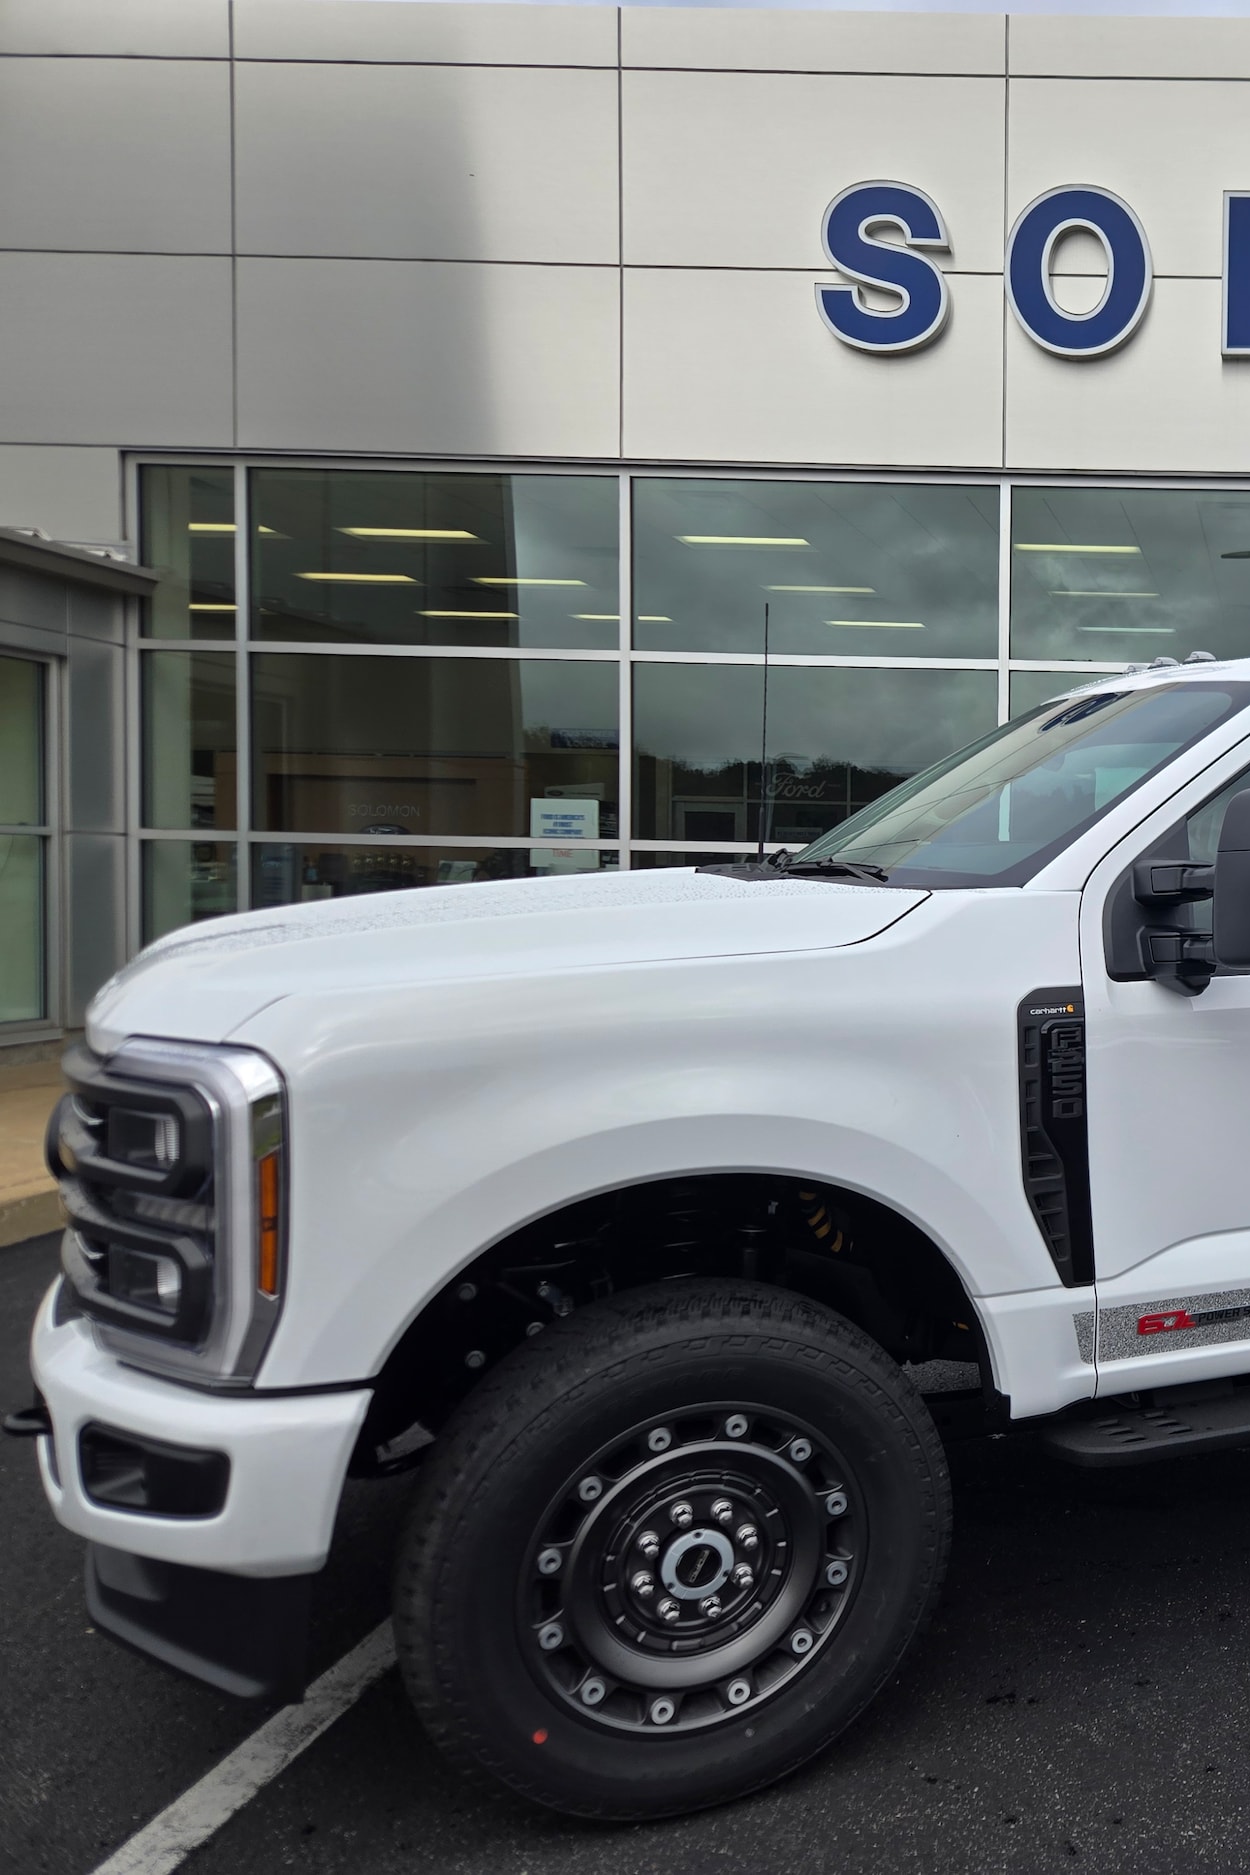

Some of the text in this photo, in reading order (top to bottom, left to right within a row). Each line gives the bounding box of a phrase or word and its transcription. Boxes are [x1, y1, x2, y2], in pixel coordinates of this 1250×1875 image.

[766, 772, 825, 798] Ford
[348, 804, 421, 817] SOLOMON
[1030, 1007, 1066, 1015] carhartt
[1198, 1309, 1240, 1323] POWER
